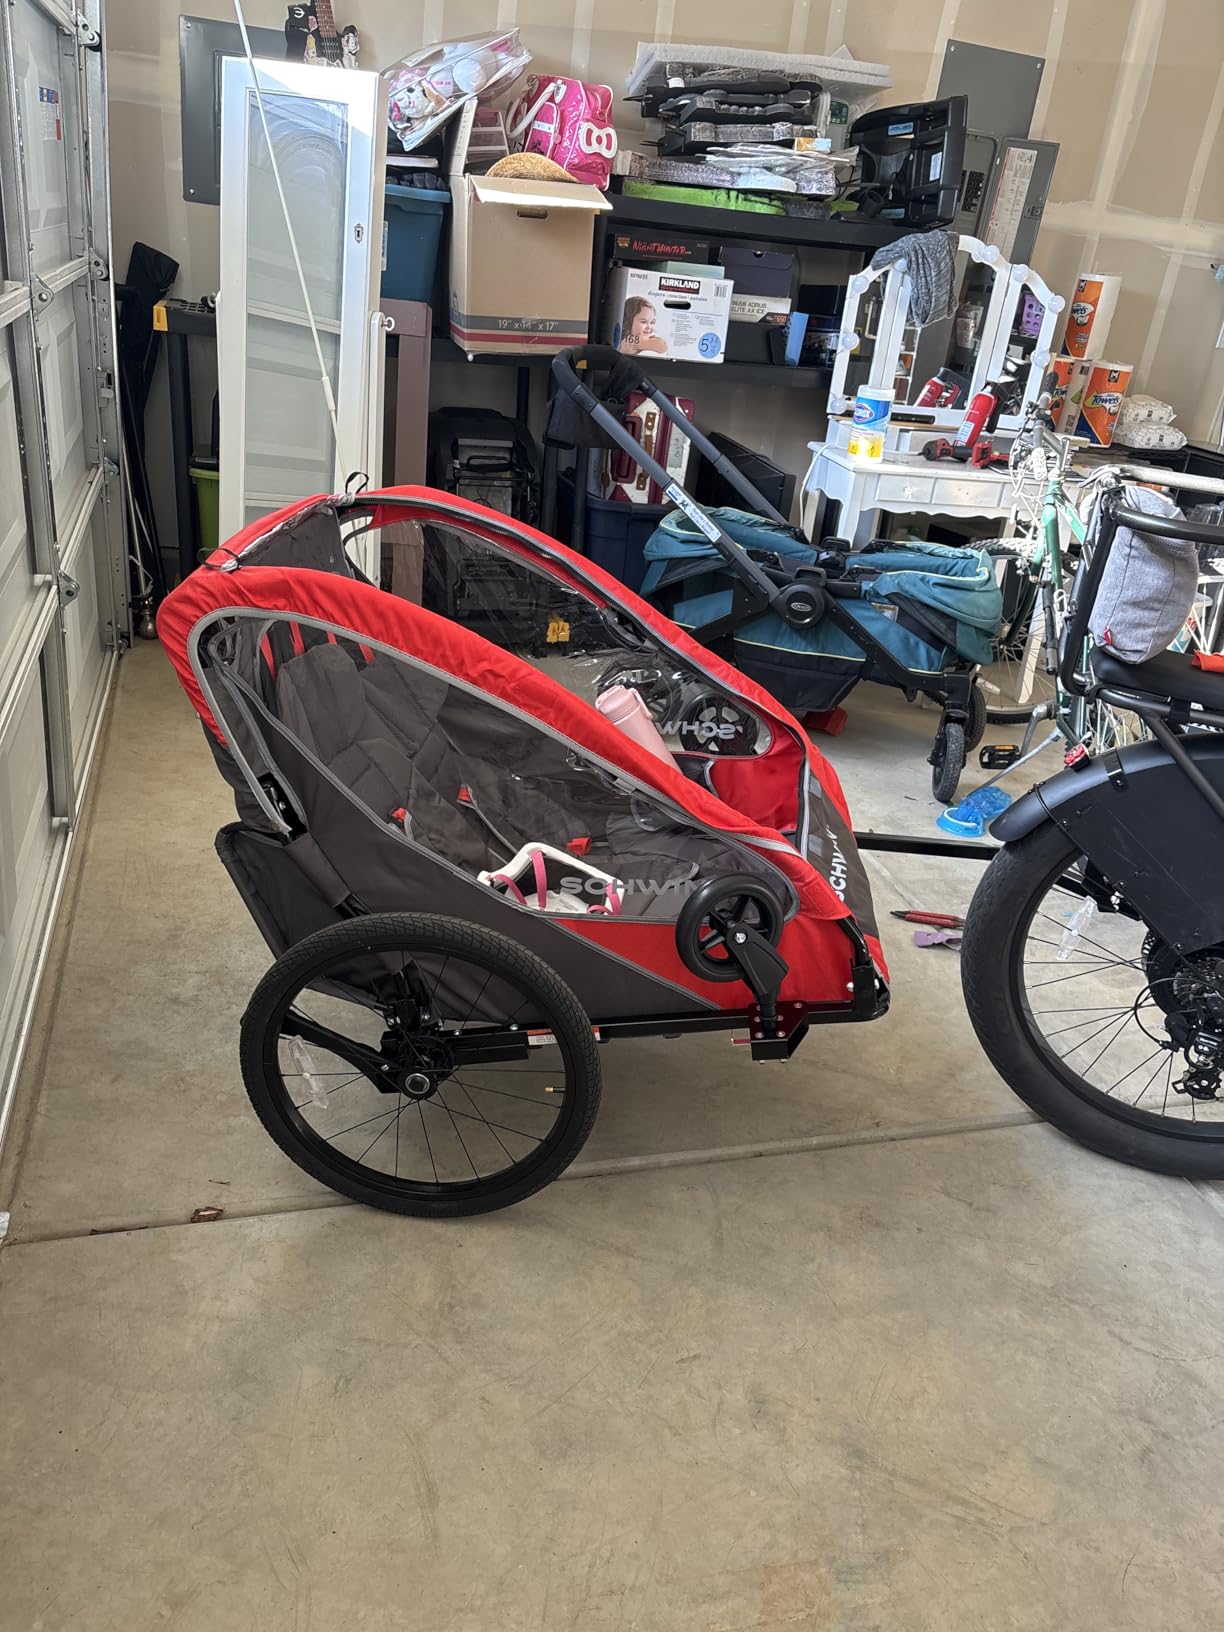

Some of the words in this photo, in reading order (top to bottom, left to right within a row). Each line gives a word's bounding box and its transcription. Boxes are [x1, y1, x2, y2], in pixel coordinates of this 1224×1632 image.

[661, 278, 699, 289] KIRKLAND
[625, 336, 640, 344] 168
[700, 338, 709, 352] 5
[1092, 394, 1120, 405] Towels
[560, 876, 705, 896] SCHWIN
